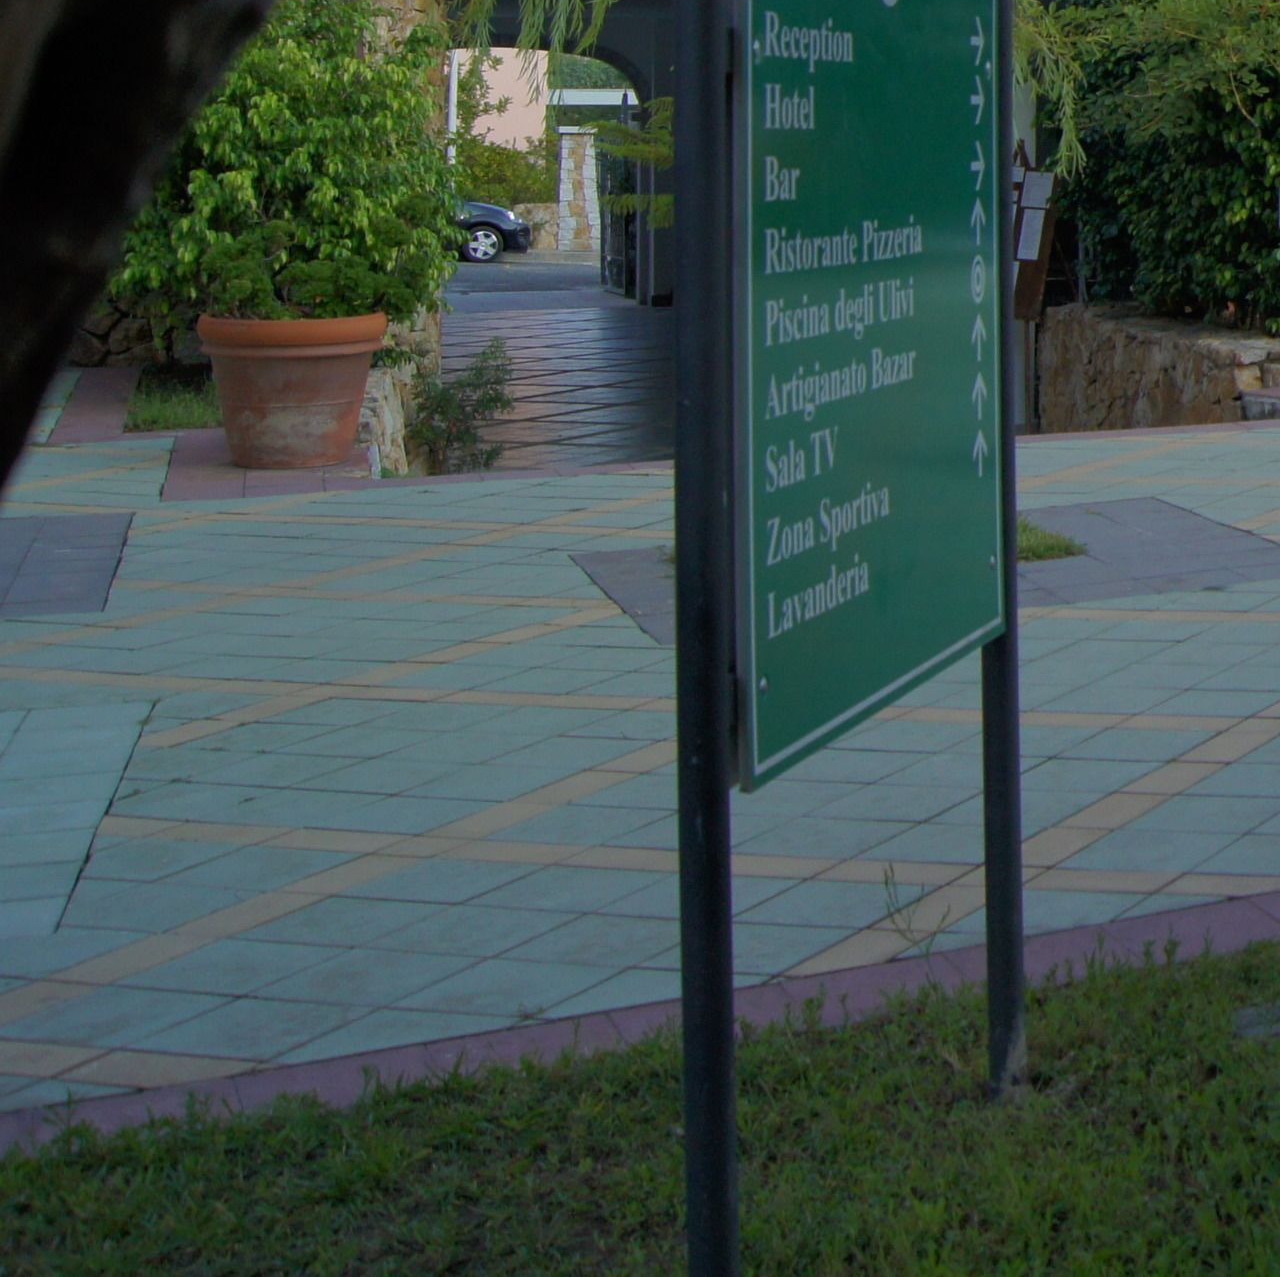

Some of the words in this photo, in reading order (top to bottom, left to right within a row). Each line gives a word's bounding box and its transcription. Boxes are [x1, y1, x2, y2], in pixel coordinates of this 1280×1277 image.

[764, 10, 854, 73] Reception
[764, 83, 816, 130] Hotel
[764, 155, 801, 201] Bar
[765, 226, 858, 274] Ristorante
[862, 214, 923, 263] Pizzeria
[765, 294, 830, 347] Piscina
[834, 282, 874, 340] degli
[878, 276, 915, 323] Ulivi
[765, 358, 867, 421] Artigianato
[871, 347, 917, 390] Bazar
[765, 439, 806, 493] Sala
[810, 426, 839, 476] TV
[767, 517, 815, 566] Zona
[820, 481, 891, 551] Sportiva
[768, 553, 870, 639] Lavanderia
